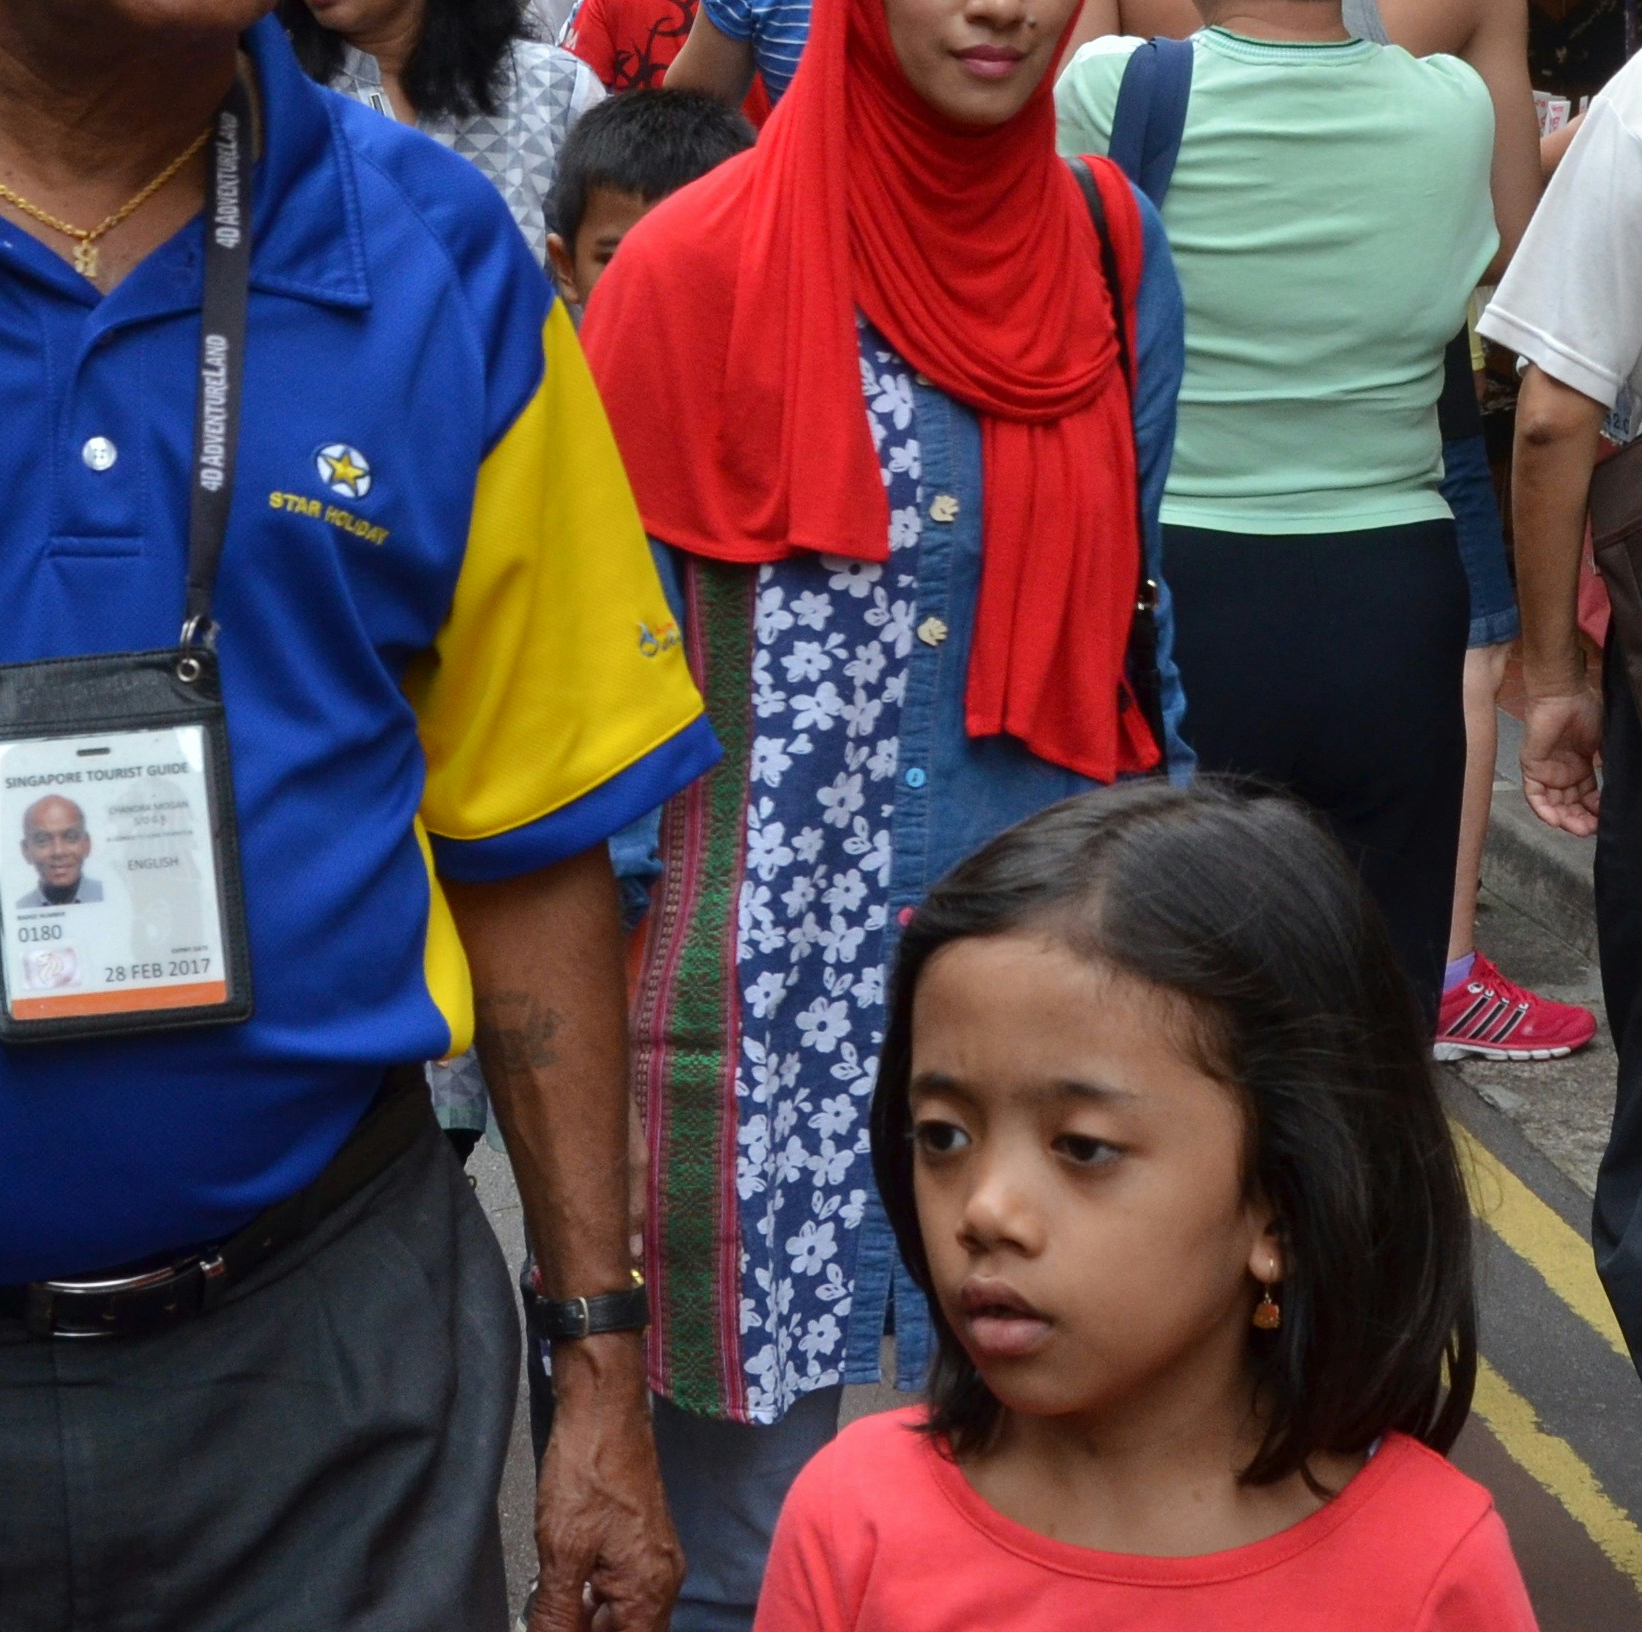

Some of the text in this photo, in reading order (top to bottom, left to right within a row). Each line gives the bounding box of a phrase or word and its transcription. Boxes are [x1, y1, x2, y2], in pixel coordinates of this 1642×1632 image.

[200, 467, 224, 493] 4D
[269, 491, 390, 546] STAR HOLIDAY
[5, 762, 190, 789] SINGAPORE TOURIST GUIDE
[127, 856, 180, 871] ENGLISH
[18, 924, 62, 943] 0180
[105, 959, 211, 982] 28 FEB 2017
